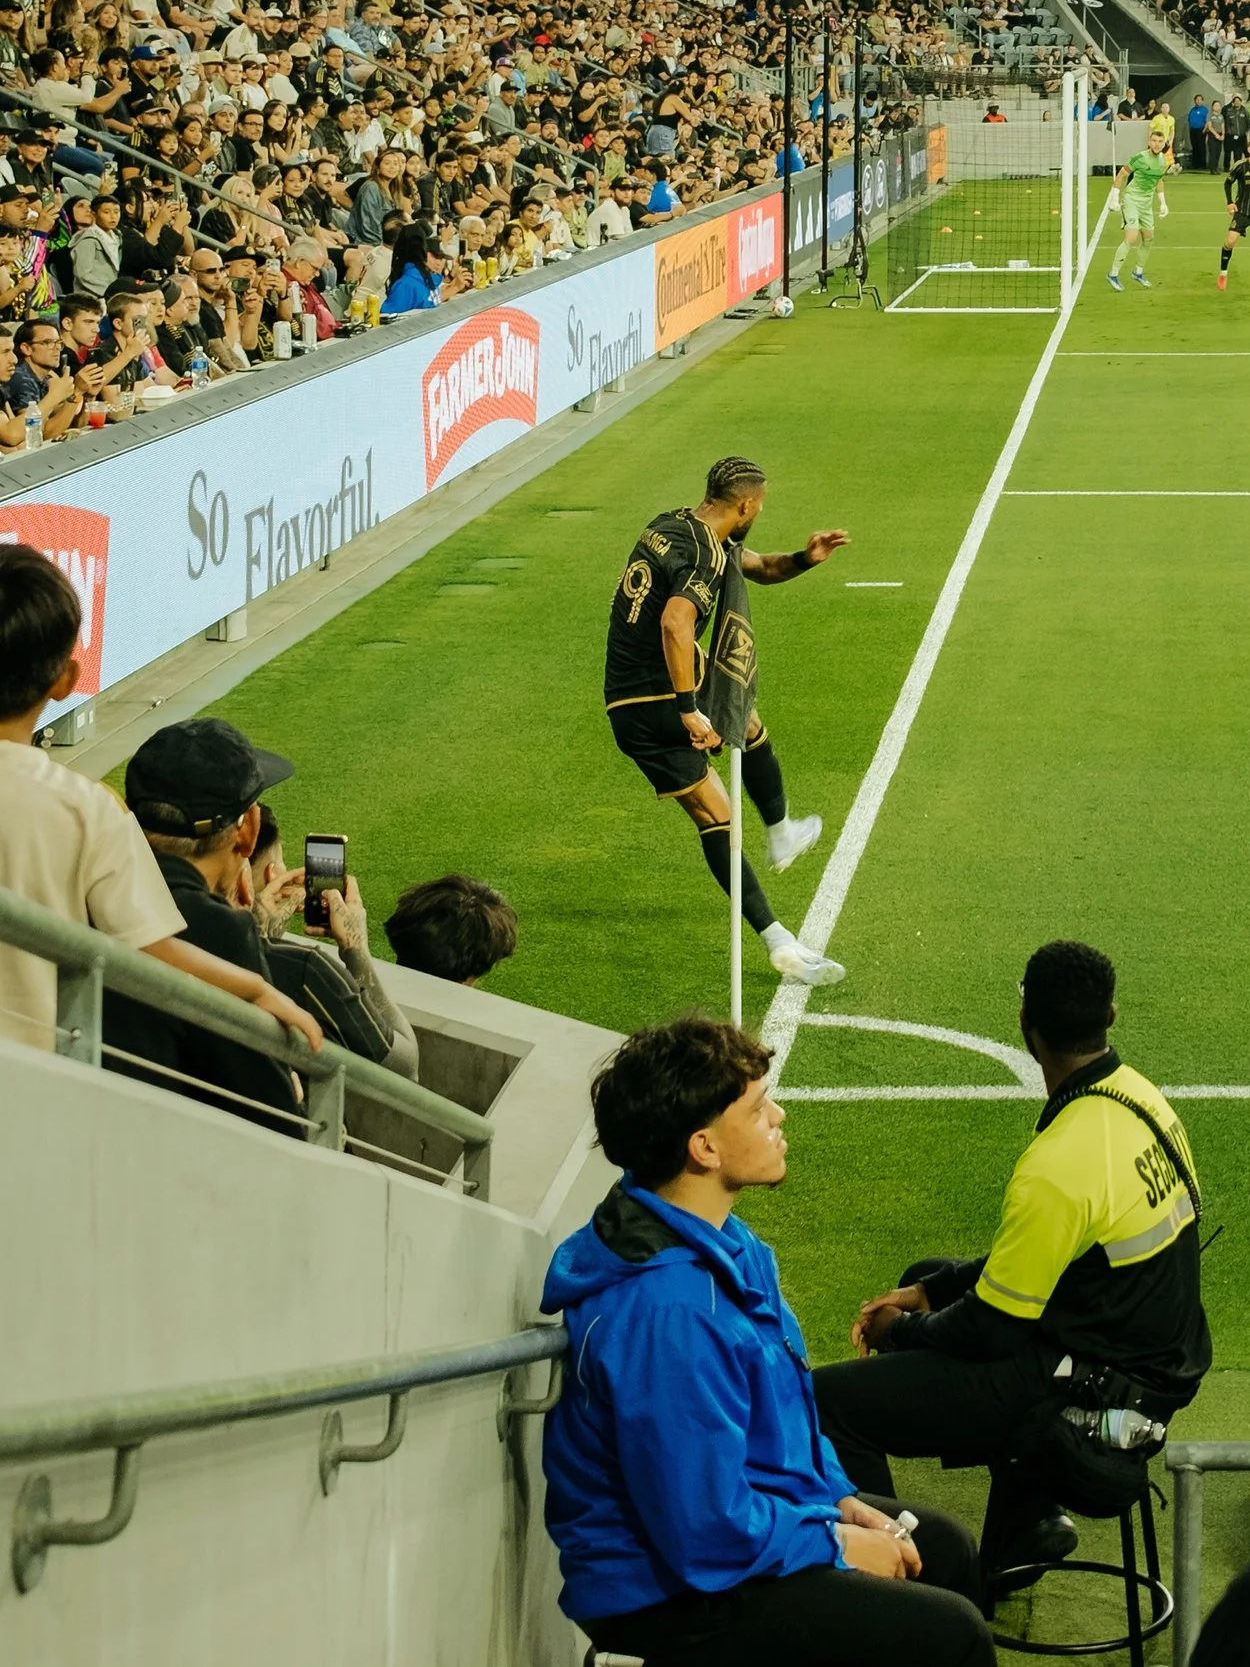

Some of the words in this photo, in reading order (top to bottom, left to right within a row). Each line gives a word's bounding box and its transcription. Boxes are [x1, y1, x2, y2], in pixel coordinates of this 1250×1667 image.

[567, 304, 584, 372] So
[656, 242, 703, 334] Continental
[708, 234, 727, 290] Tire
[427, 336, 495, 462] FARMER
[494, 321, 536, 401] JOHN
[187, 469, 229, 581] So
[244, 446, 380, 604] Flavorful.
